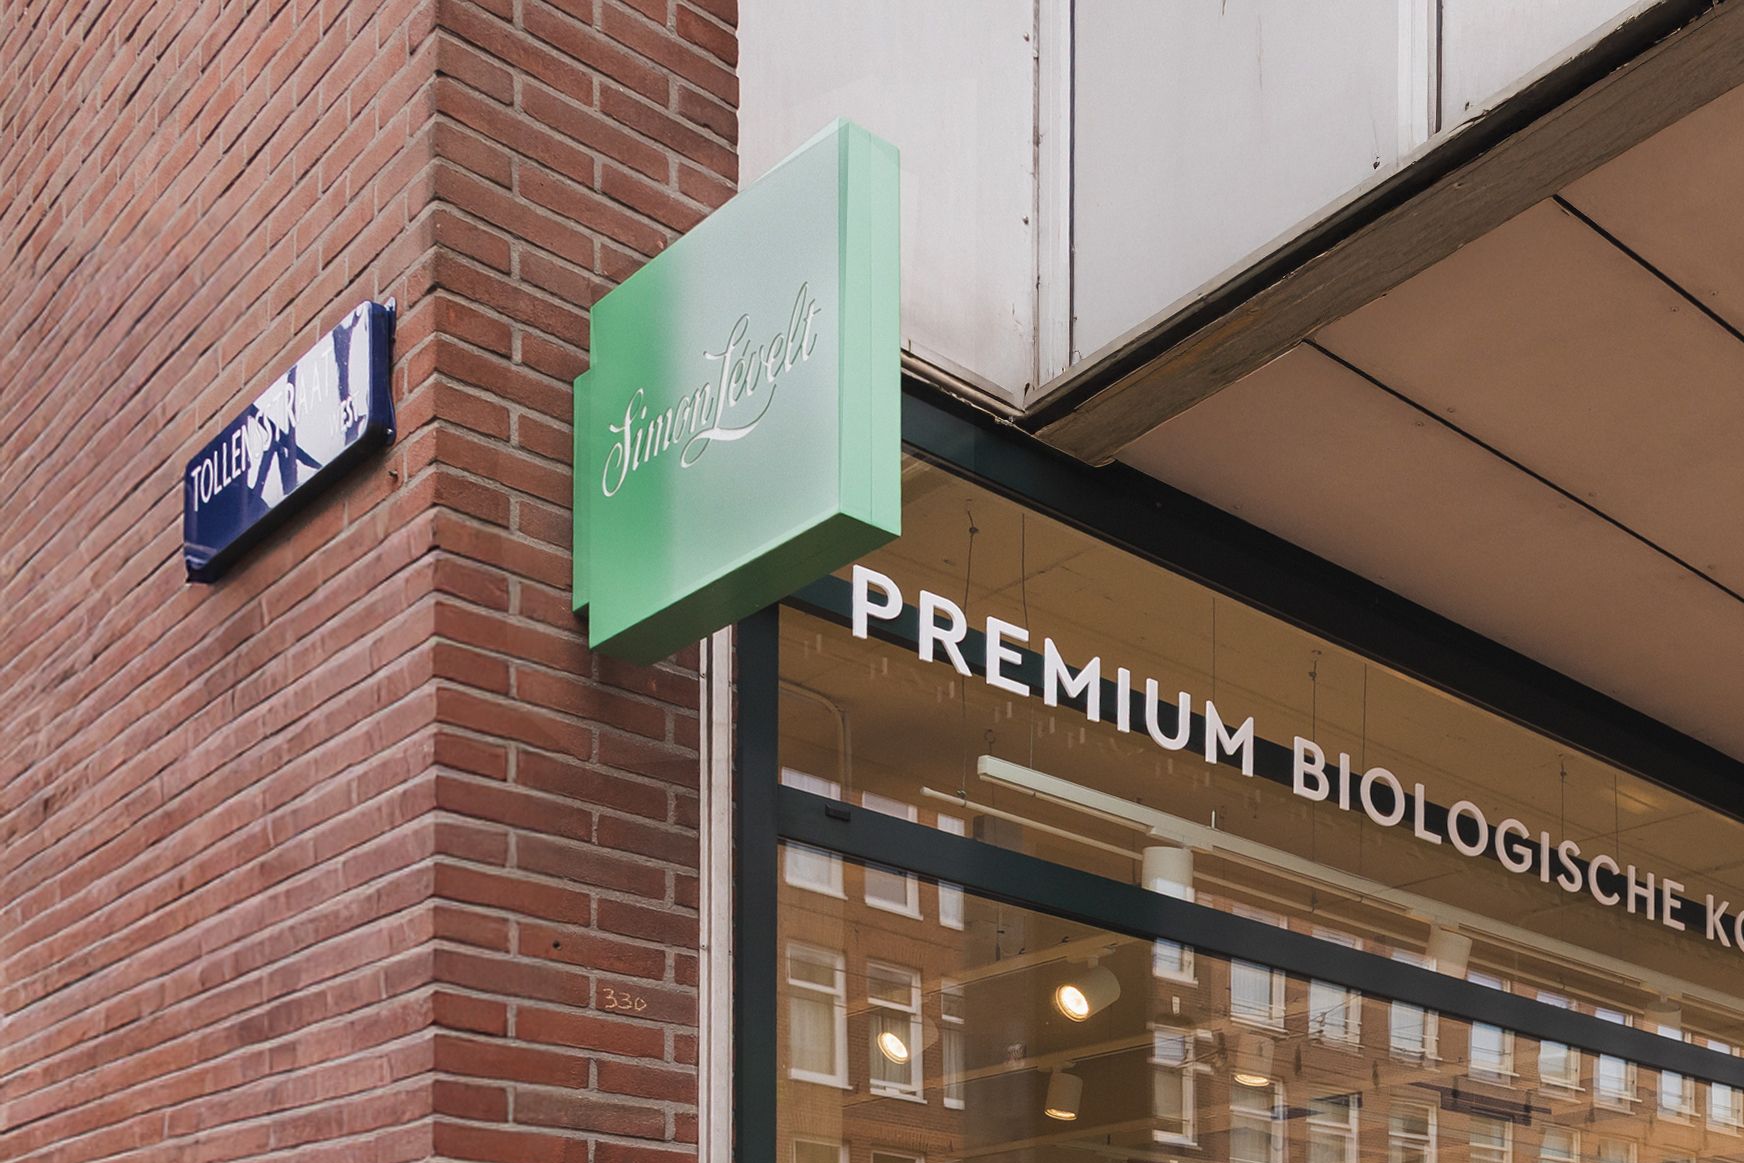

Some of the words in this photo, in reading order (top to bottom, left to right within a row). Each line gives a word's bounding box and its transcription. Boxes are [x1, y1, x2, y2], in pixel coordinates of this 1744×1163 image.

[602, 387, 714, 498] Simon
[851, 563, 1256, 778] PREMIUM
[1292, 735, 1686, 932] BIOLOGISCHE
